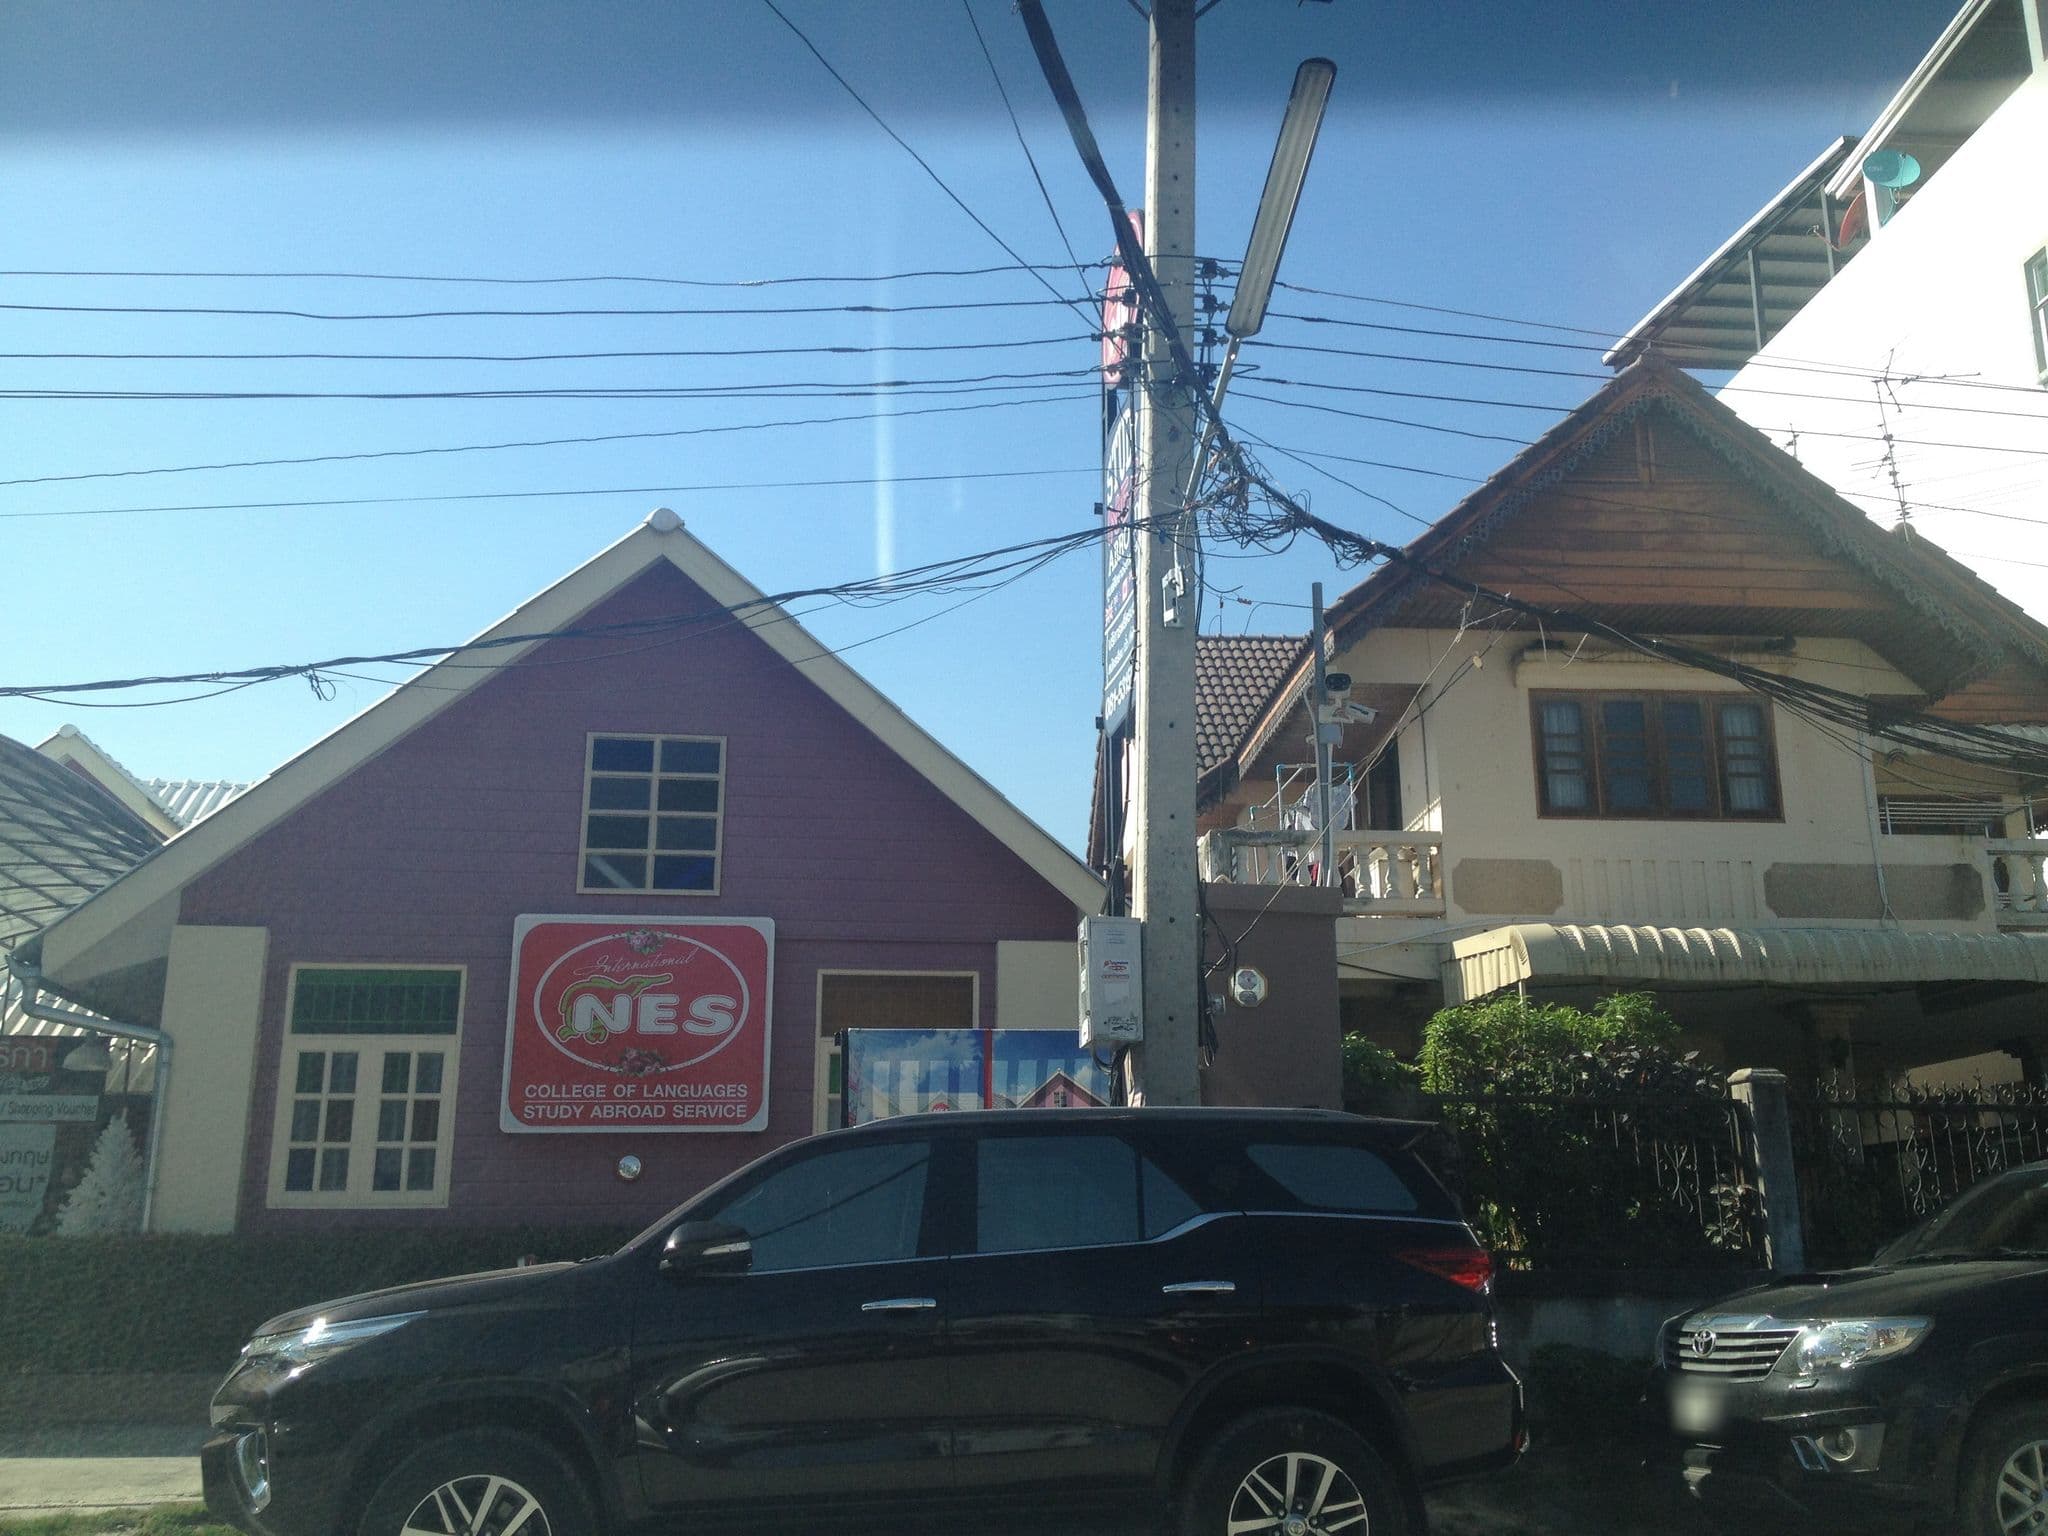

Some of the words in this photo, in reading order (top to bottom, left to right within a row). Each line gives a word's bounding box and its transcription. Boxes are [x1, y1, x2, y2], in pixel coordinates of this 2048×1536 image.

[572, 993, 737, 1036] NES
[524, 1084, 606, 1098] COLLEGE
[613, 1084, 637, 1098] OF
[643, 1084, 748, 1098] LANGUAGES
[523, 1105, 583, 1119] STUDY
[590, 1105, 666, 1119] ABROAD
[672, 1105, 747, 1119] SERVICE
